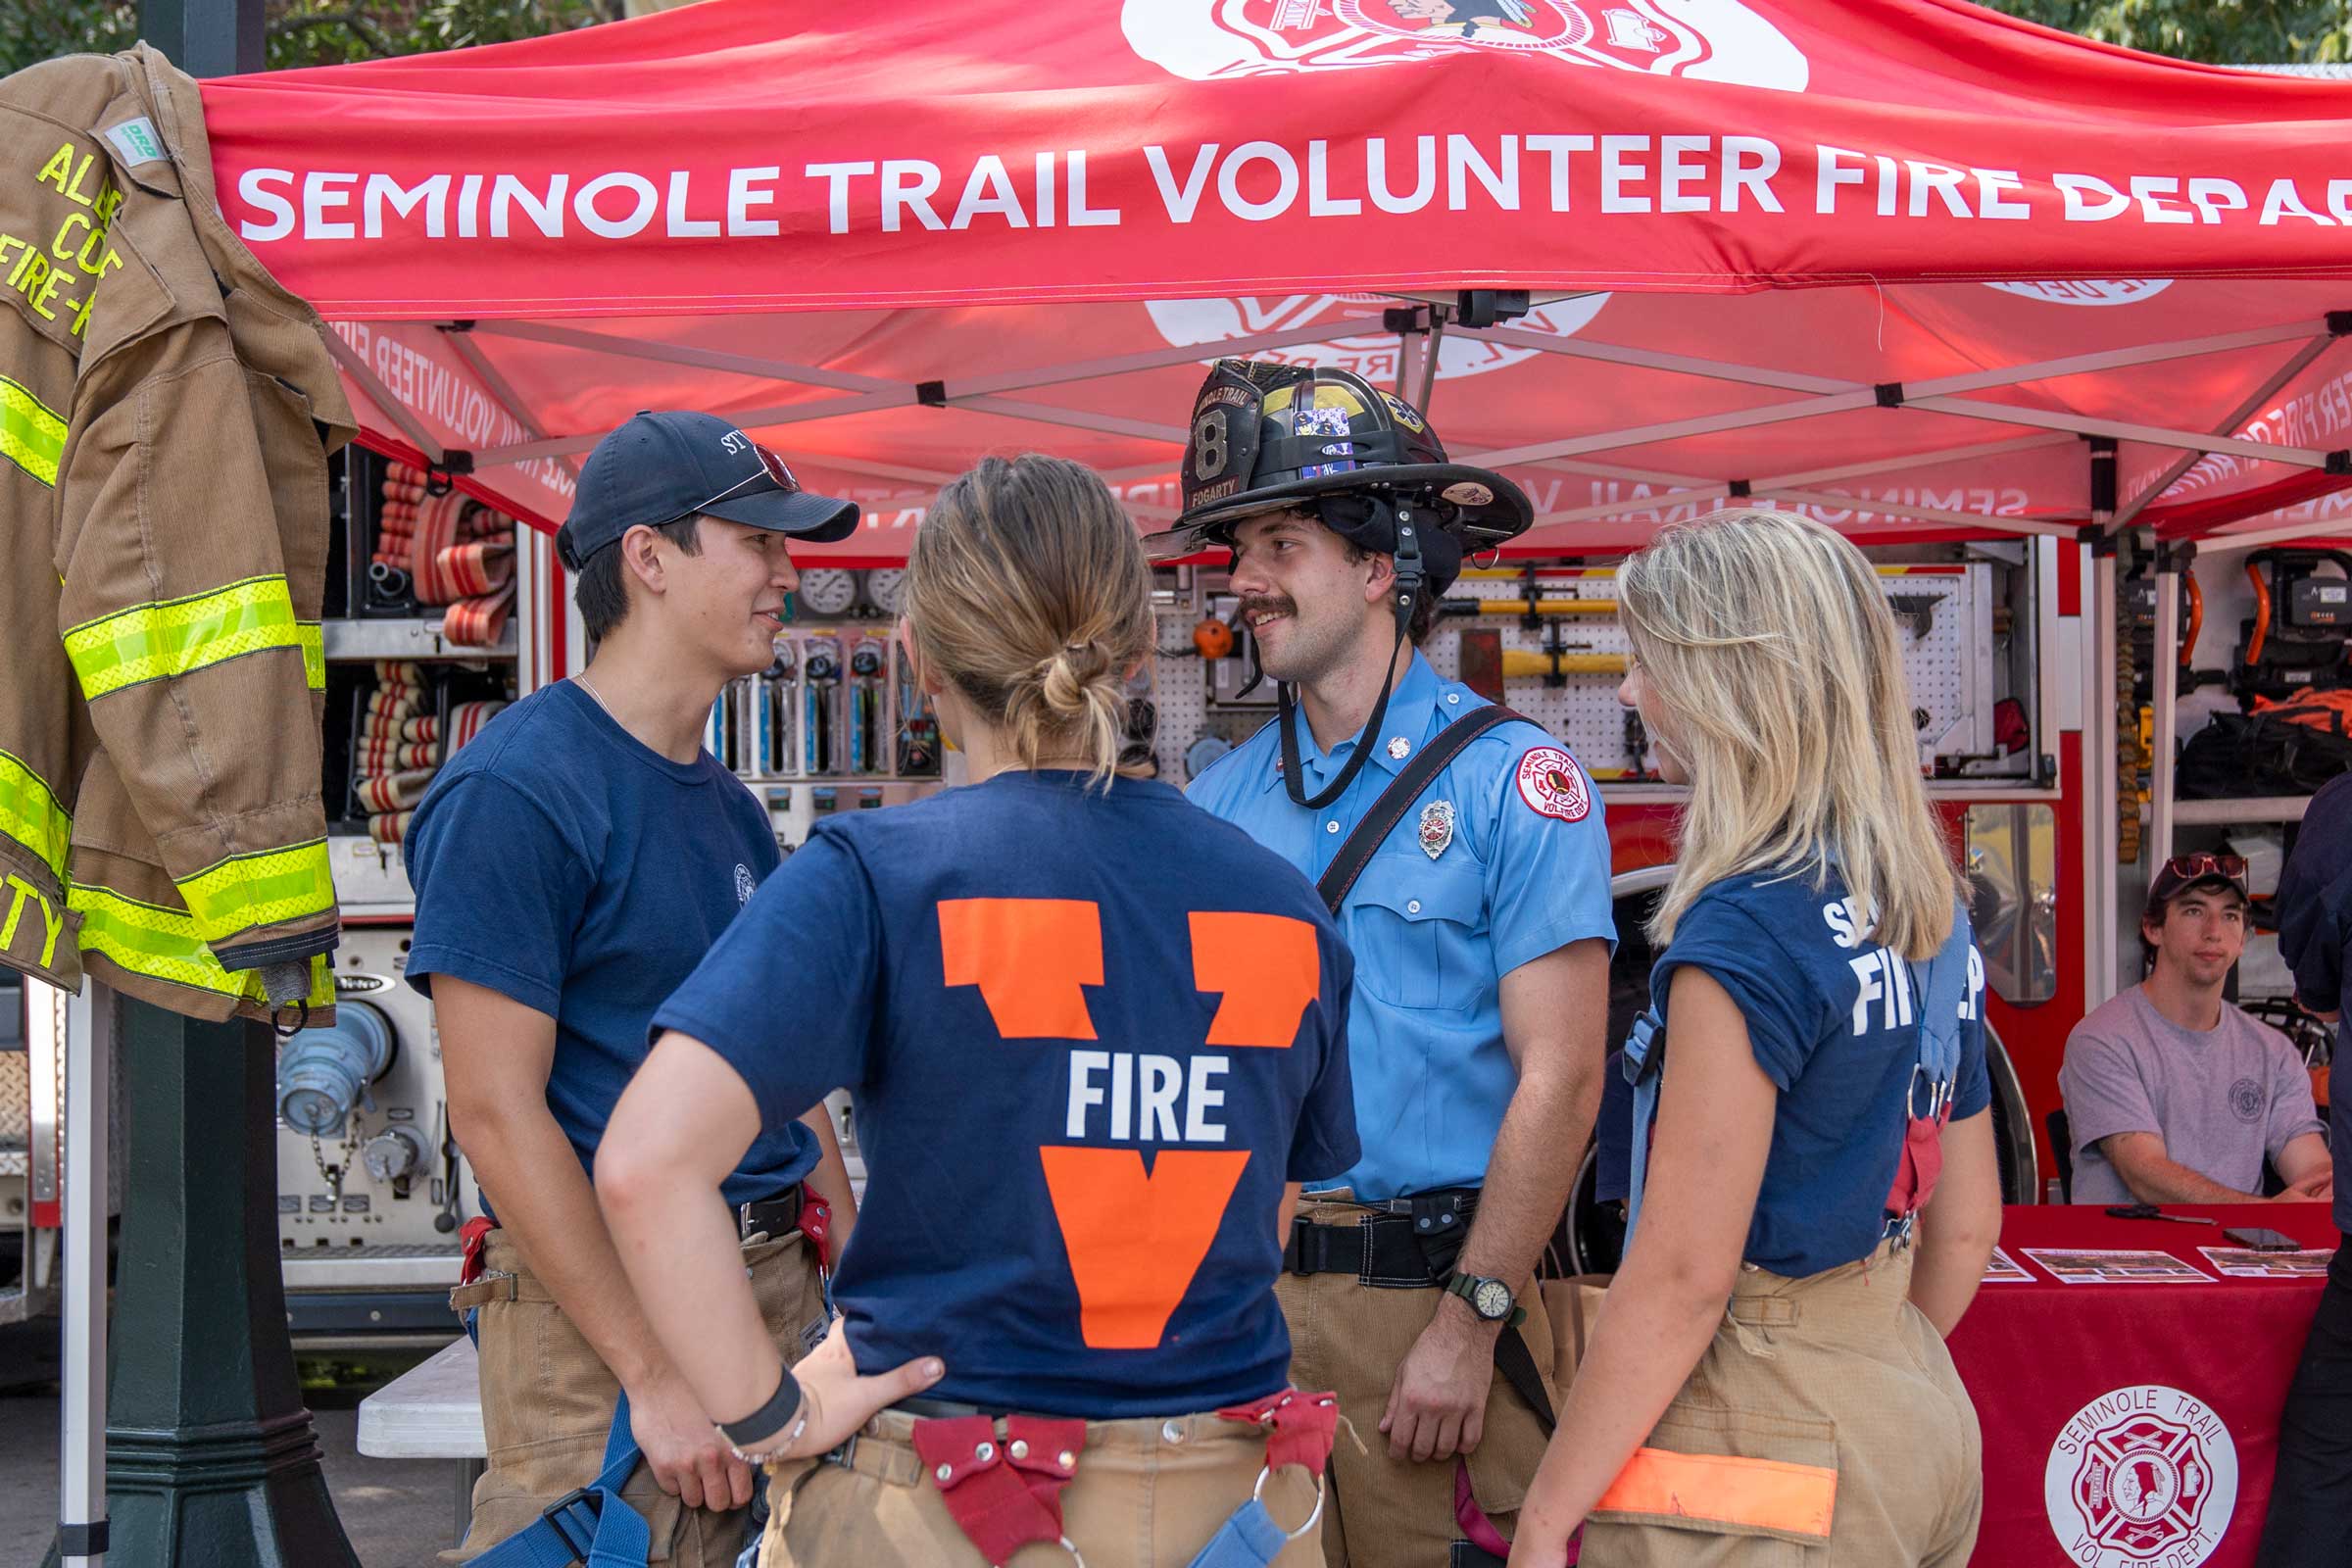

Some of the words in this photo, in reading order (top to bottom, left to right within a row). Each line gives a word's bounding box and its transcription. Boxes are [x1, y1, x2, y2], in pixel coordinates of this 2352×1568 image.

[238, 167, 780, 241] SEMINOLE
[805, 149, 1121, 234] TRAIL
[1143, 134, 1786, 223] VOLUNTEER
[1816, 144, 2031, 220] FIRE
[1222, 386, 1249, 406] TRAIL
[1195, 409, 1227, 481] 8
[1192, 479, 1236, 508] FOGARTY
[1521, 751, 1549, 780] SEMINOLE
[1553, 752, 1575, 772] TRAIL
[1066, 1050, 1230, 1142] FIRE
[2058, 1390, 2158, 1455] SEMINOLE
[2176, 1395, 2223, 1446] TRAIL
